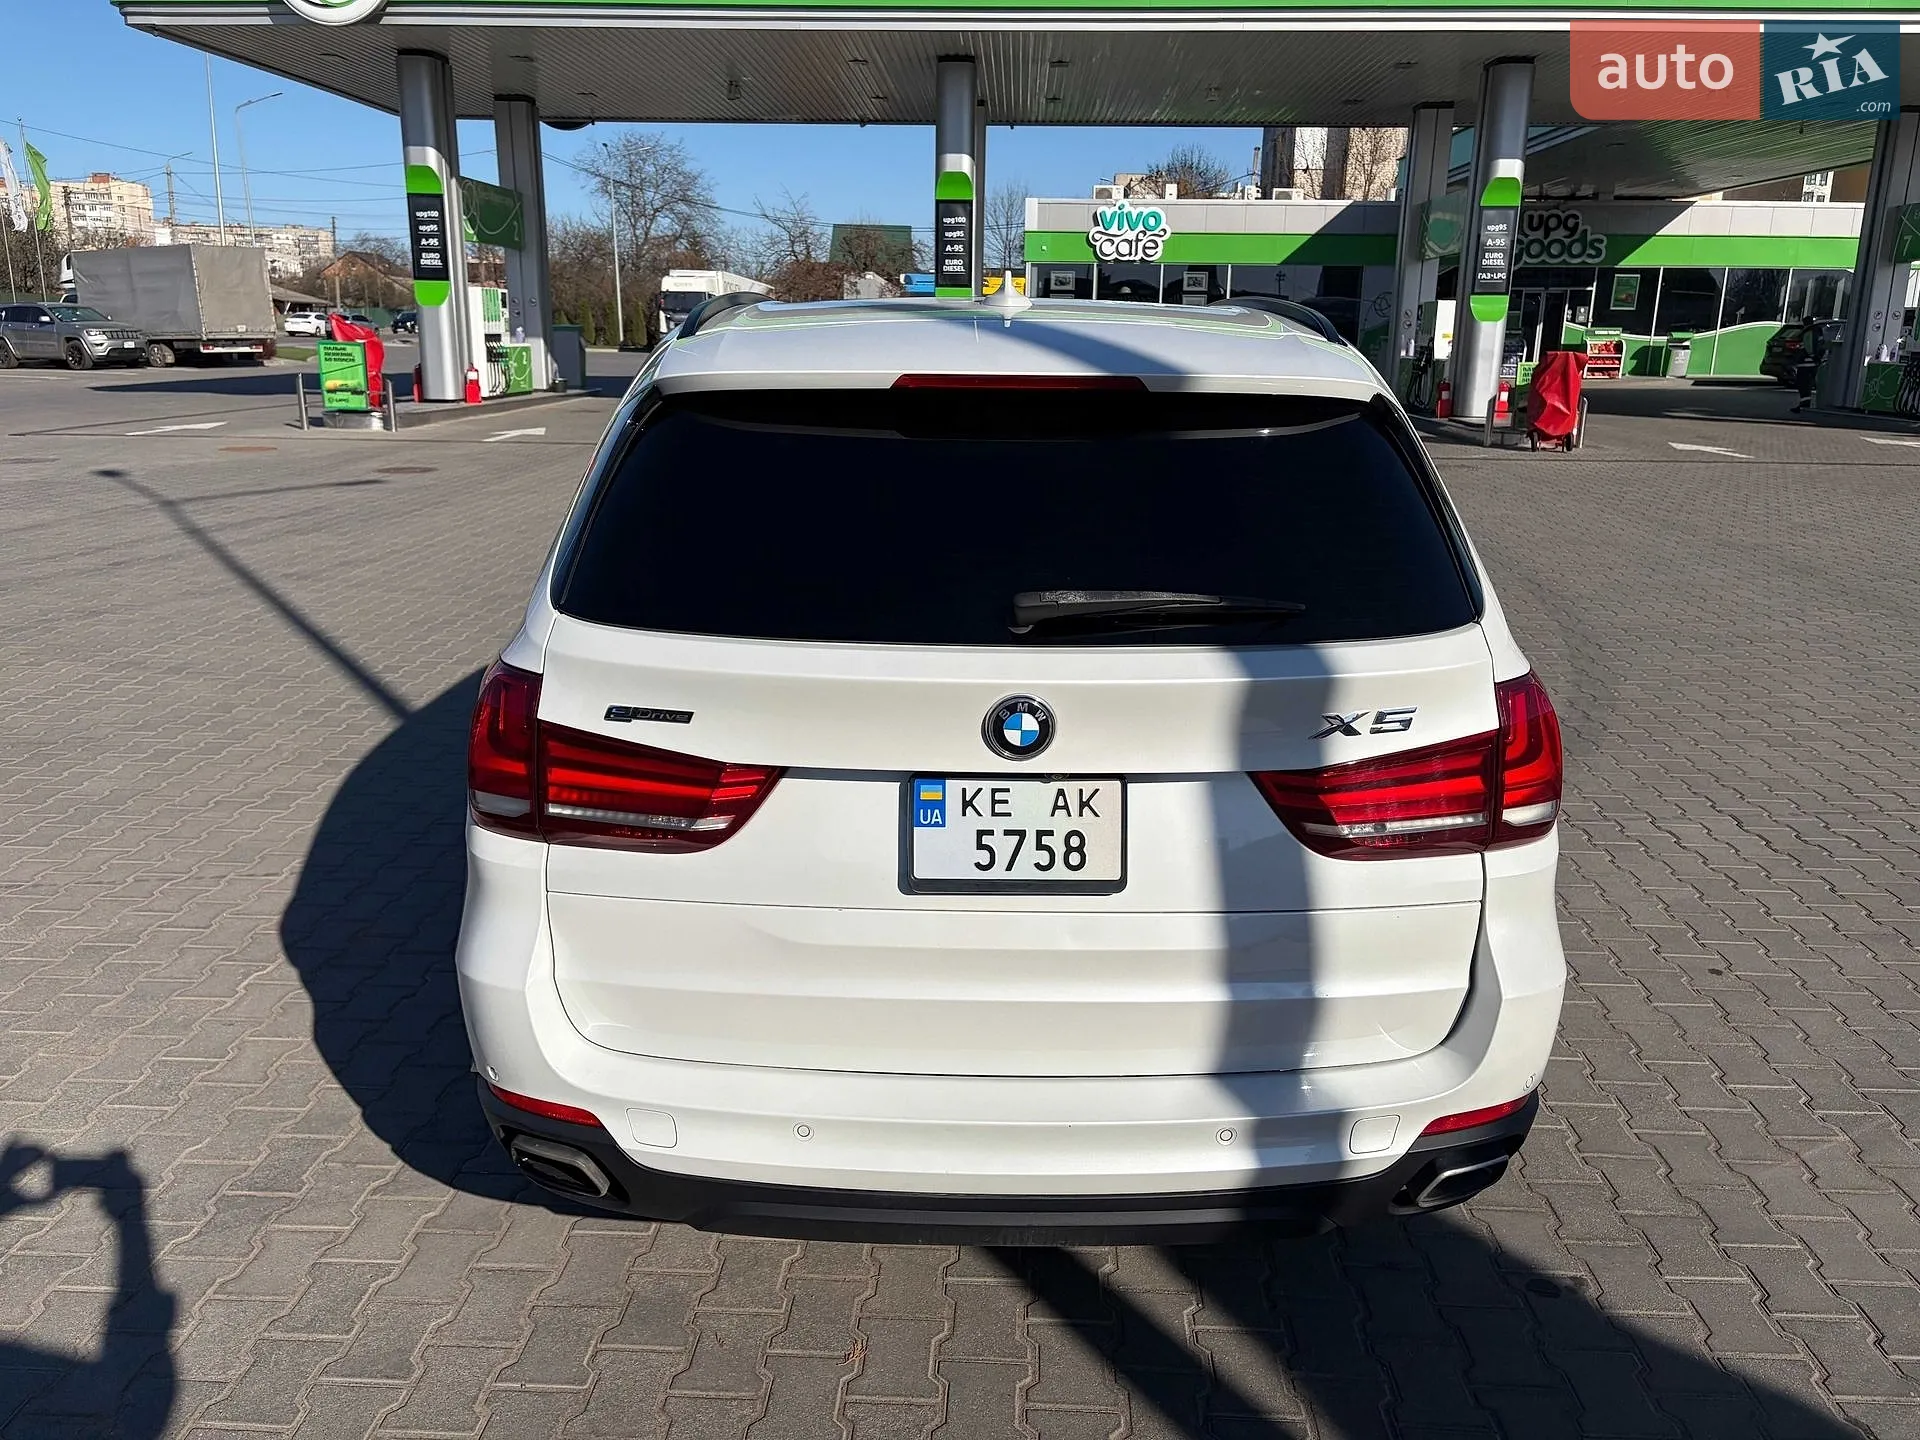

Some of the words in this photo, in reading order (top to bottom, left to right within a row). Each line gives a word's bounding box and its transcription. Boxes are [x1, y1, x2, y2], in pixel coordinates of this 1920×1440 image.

[1100, 203, 1162, 231] vivo
[1527, 213, 1581, 240] upg
[999, 703, 1047, 721] BMW
[1308, 706, 1418, 740] X5
[961, 787, 1012, 817] KE
[1050, 788, 1101, 817] AK
[920, 809, 943, 825] UA
[974, 829, 1087, 872] 5758
